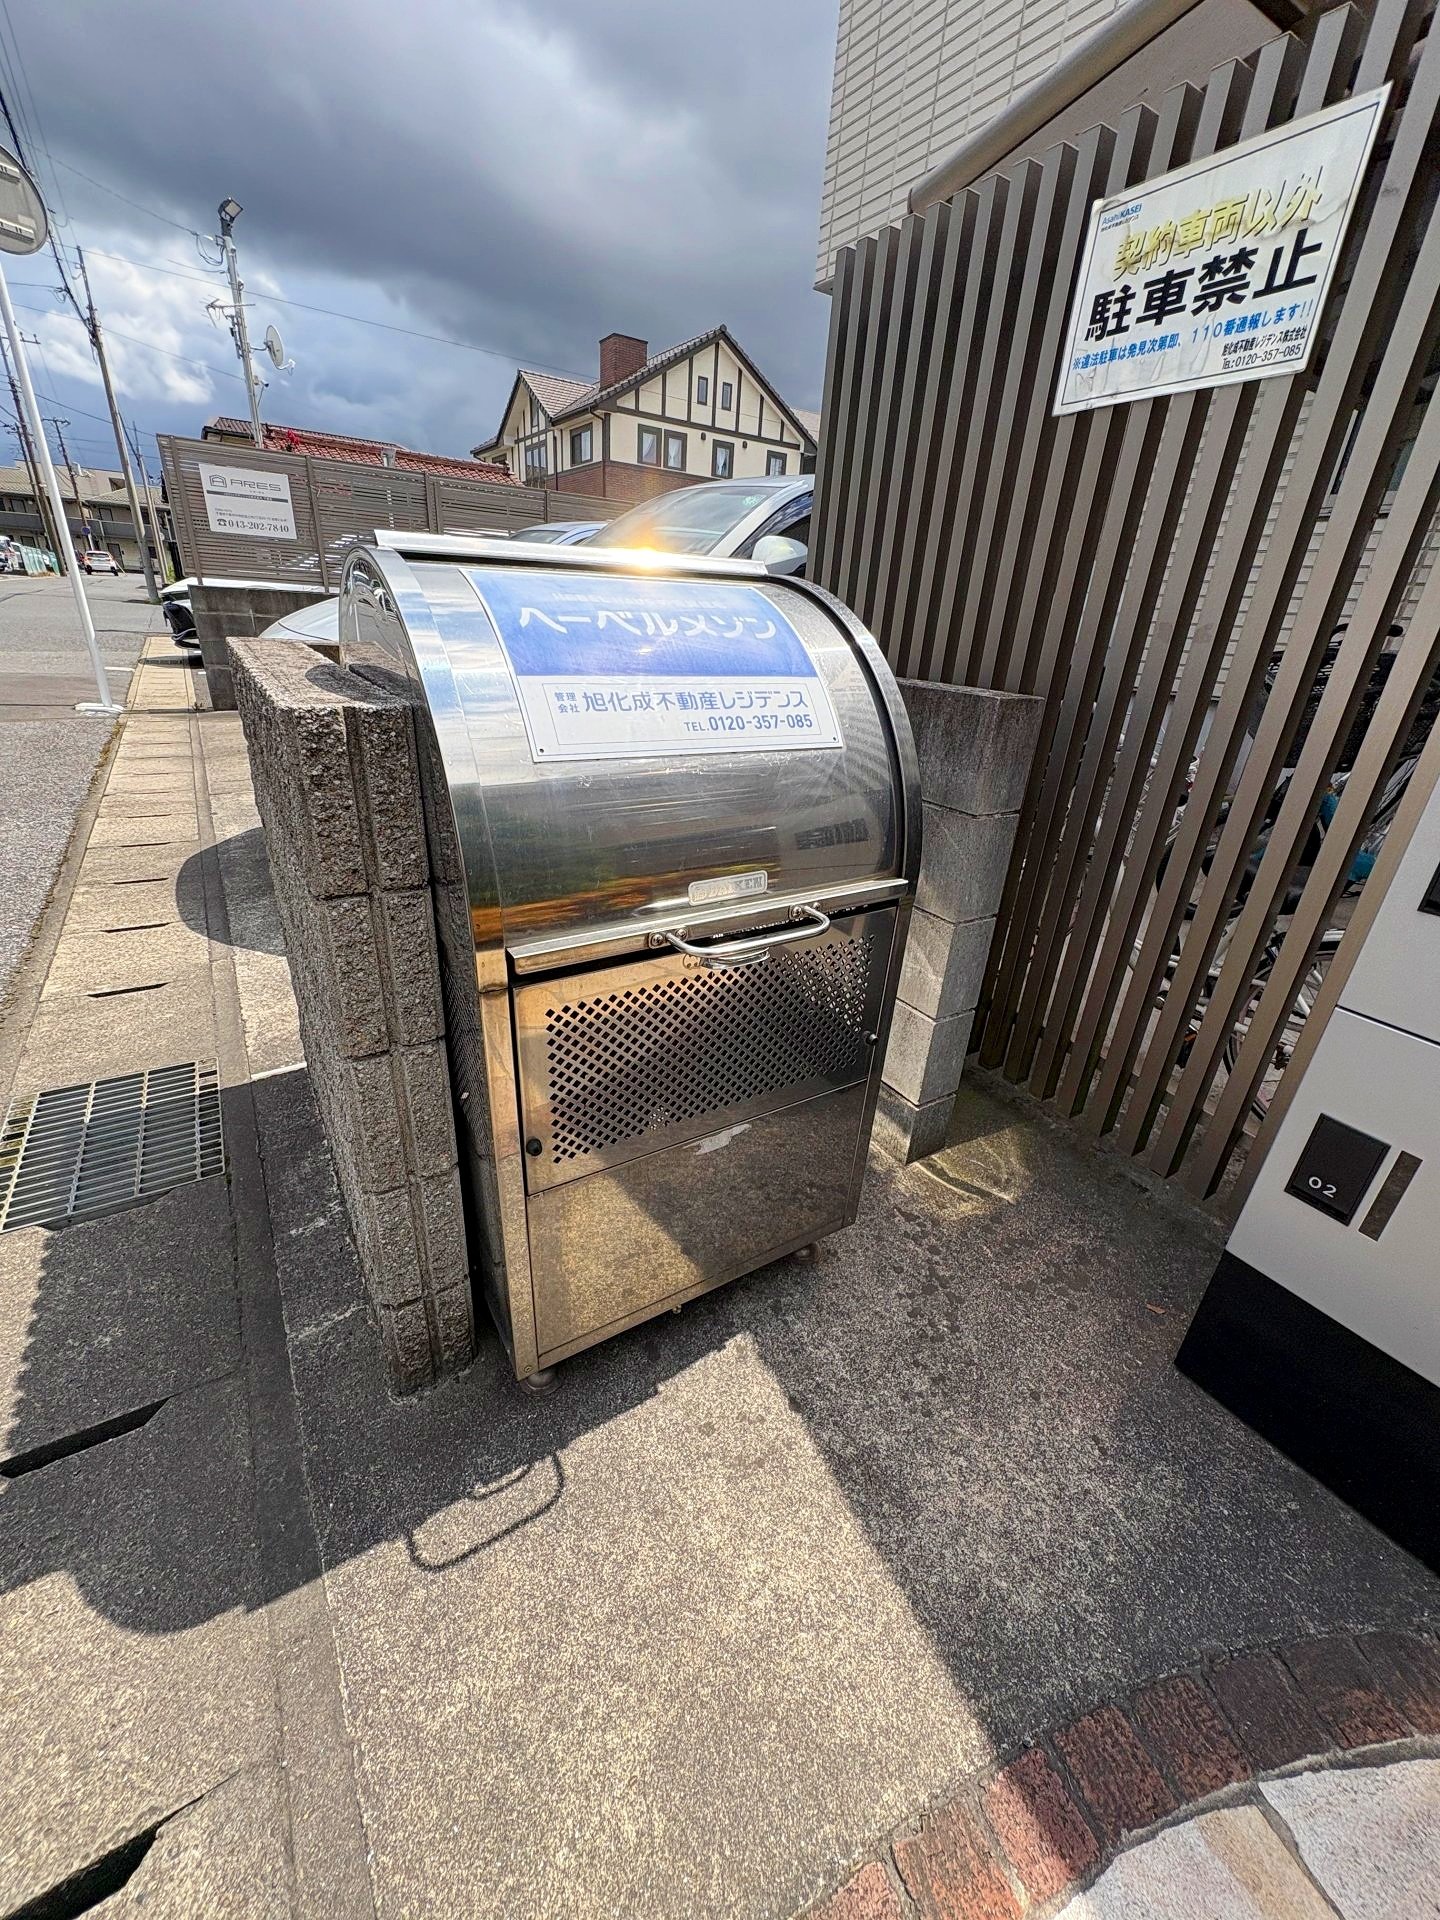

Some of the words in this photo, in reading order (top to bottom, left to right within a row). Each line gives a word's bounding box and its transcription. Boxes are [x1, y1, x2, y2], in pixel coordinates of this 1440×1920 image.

[1113, 166, 1322, 281] 契約車両以外
[1084, 228, 1323, 341] 駐車禁止
[230, 478, 282, 492] ARES
[519, 607, 776, 640] ヘーベルメゾン
[582, 690, 809, 713] 旭化成不動産レジデンス
[1308, 1176, 1337, 1198] 02
